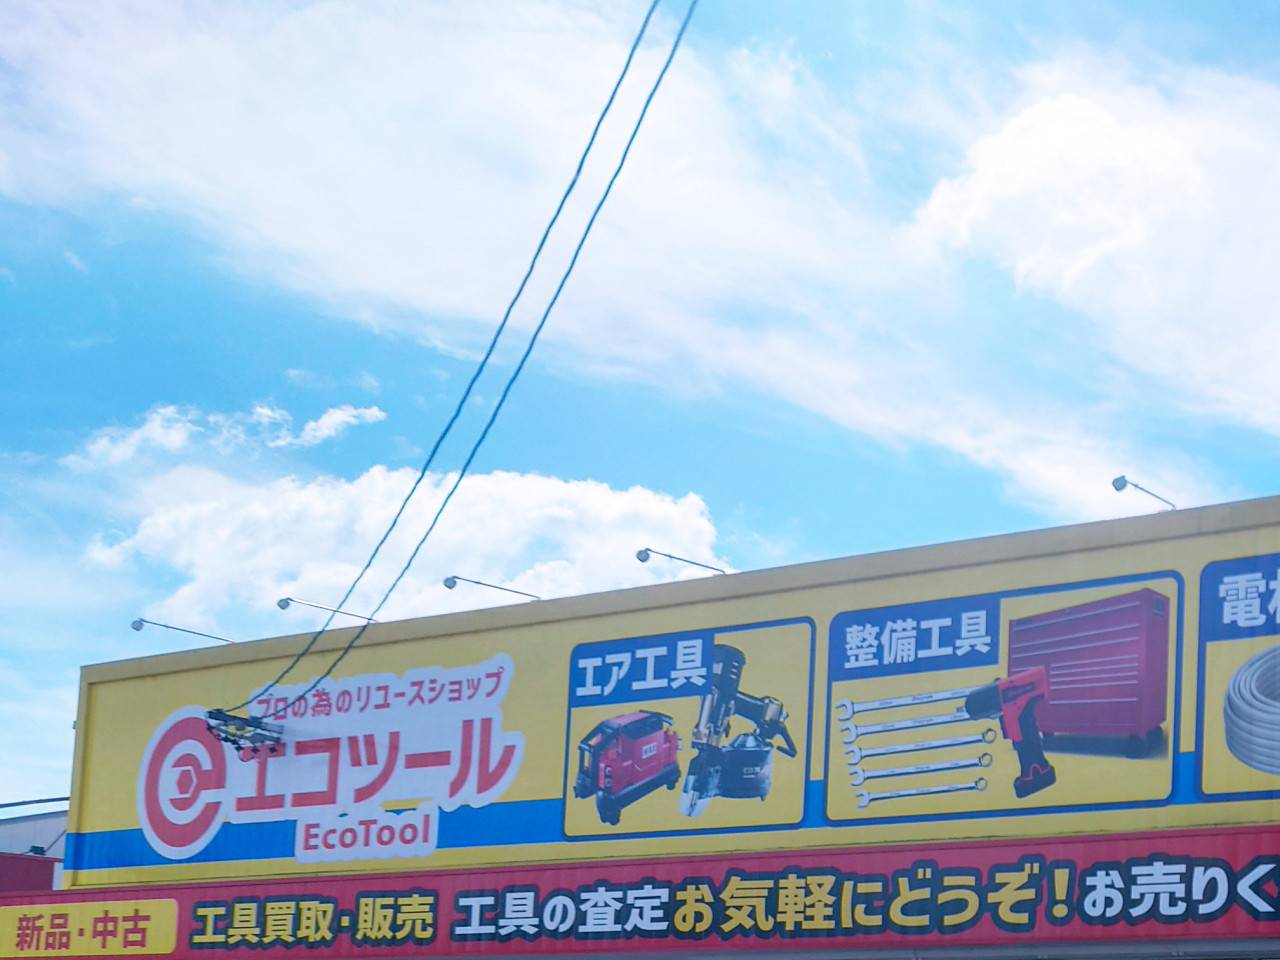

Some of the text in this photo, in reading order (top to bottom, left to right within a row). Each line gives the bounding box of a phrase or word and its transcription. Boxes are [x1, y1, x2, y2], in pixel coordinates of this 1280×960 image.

[843, 610, 992, 670] 整備工具
[576, 639, 707, 697] エア工具
[236, 718, 517, 812] エコツール
[303, 814, 431, 851] EcoTool
[15, 909, 152, 952] 新品・中古
[192, 894, 435, 945] 工具買取・販売
